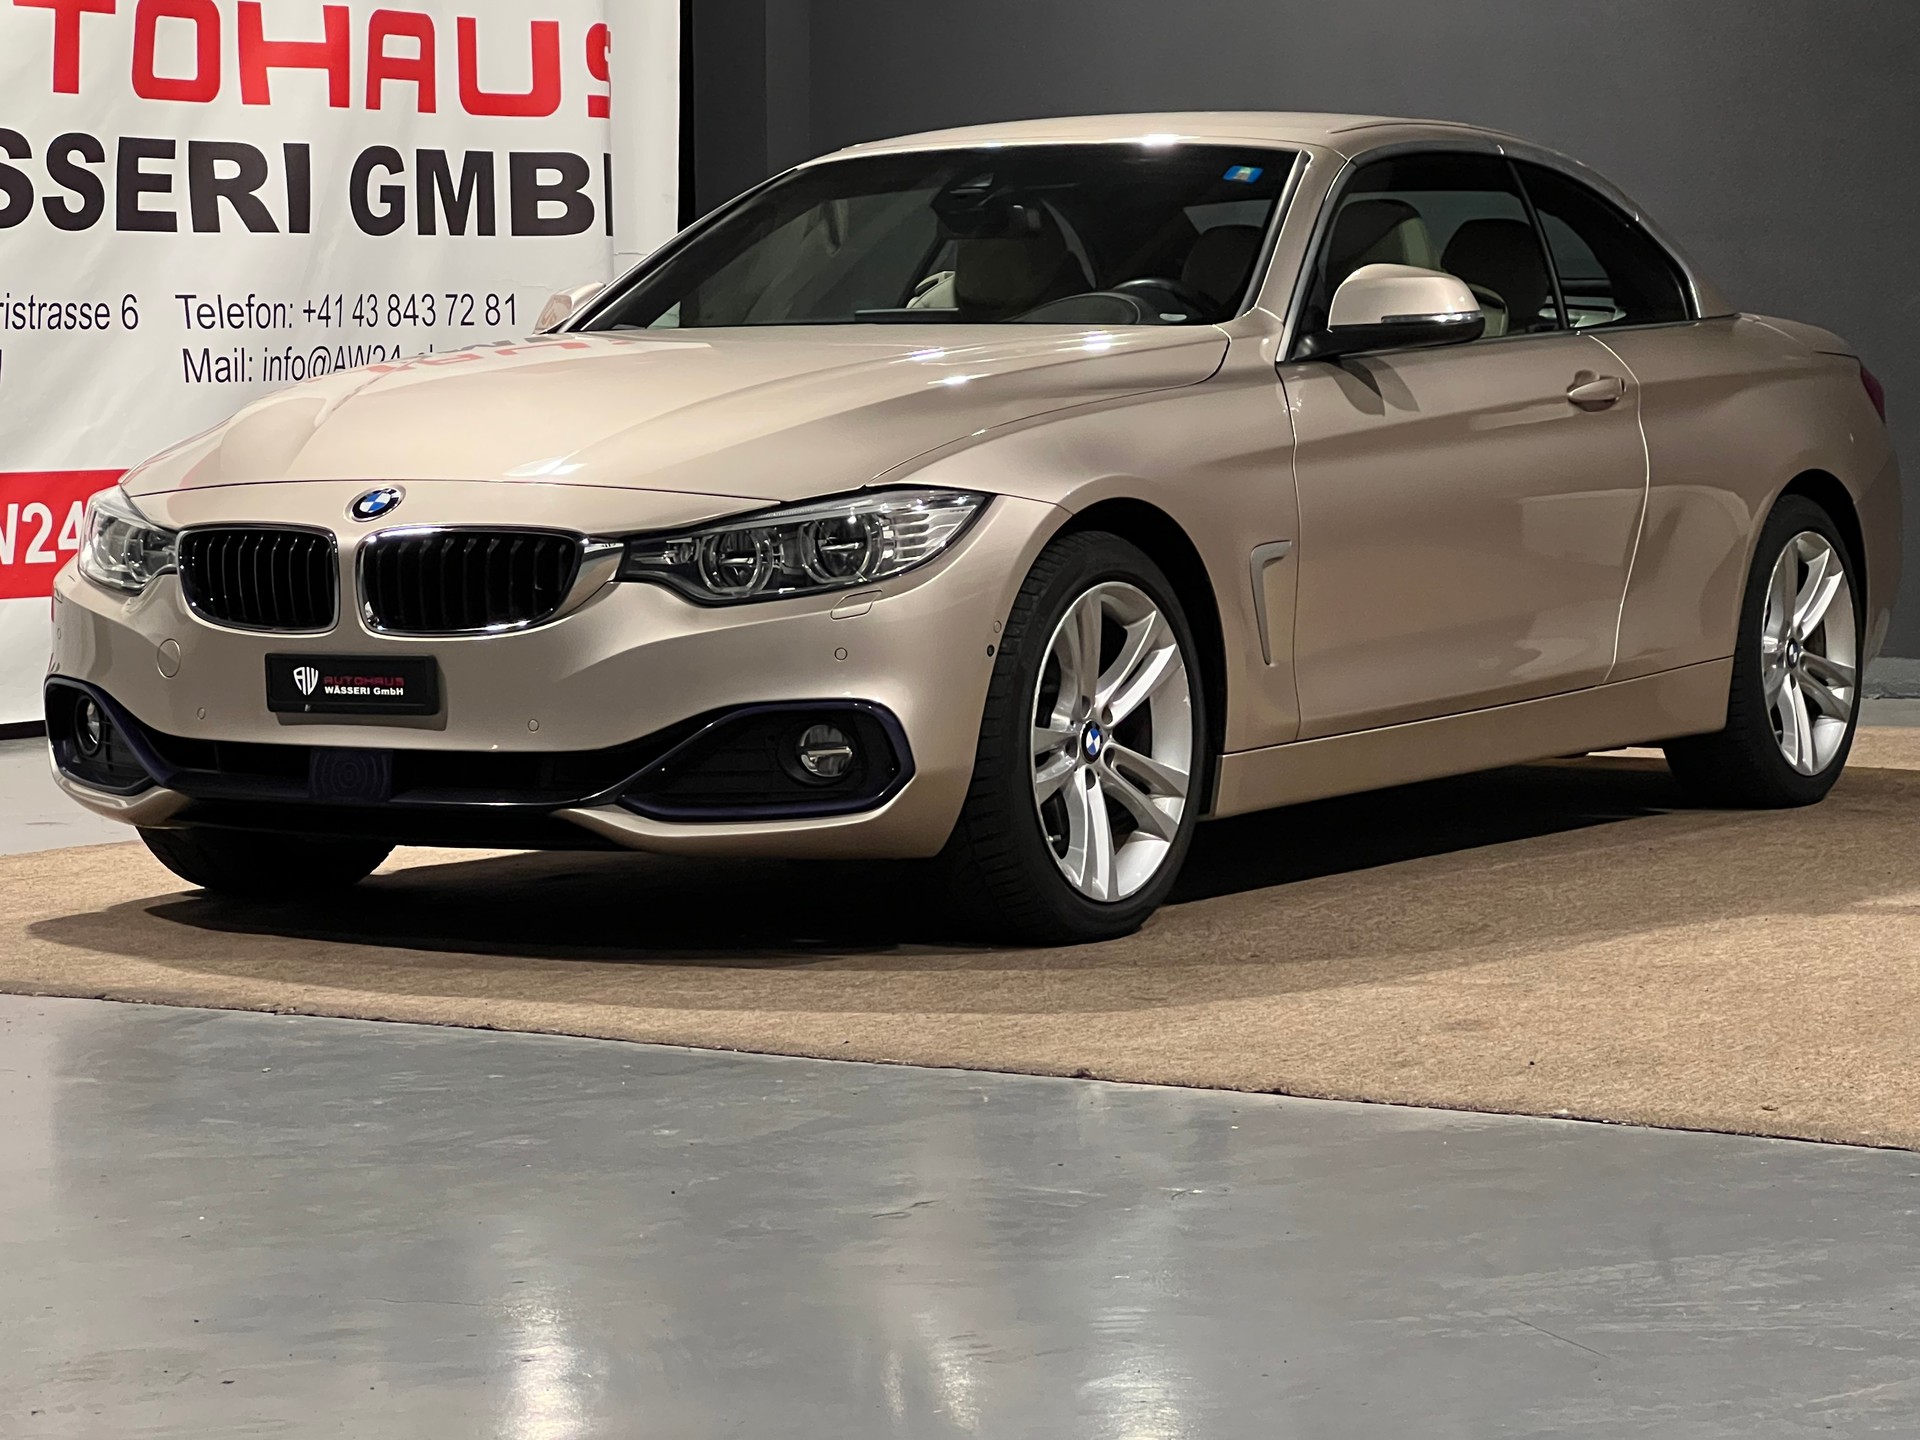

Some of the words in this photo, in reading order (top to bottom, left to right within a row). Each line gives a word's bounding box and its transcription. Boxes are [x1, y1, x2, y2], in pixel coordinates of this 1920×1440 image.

[349, 145, 613, 237] GMB
[121, 293, 139, 330] 6
[175, 293, 293, 330] Telefon:
[302, 293, 343, 329] +41
[352, 293, 378, 328] 43
[387, 293, 436, 327] 843
[445, 293, 475, 326] 72
[485, 293, 516, 326] 81
[182, 347, 253, 383] Mail:
[324, 676, 404, 686] AUTOHAUS
[324, 685, 370, 695] WÄSSERI
[373, 687, 404, 696] GmbH
